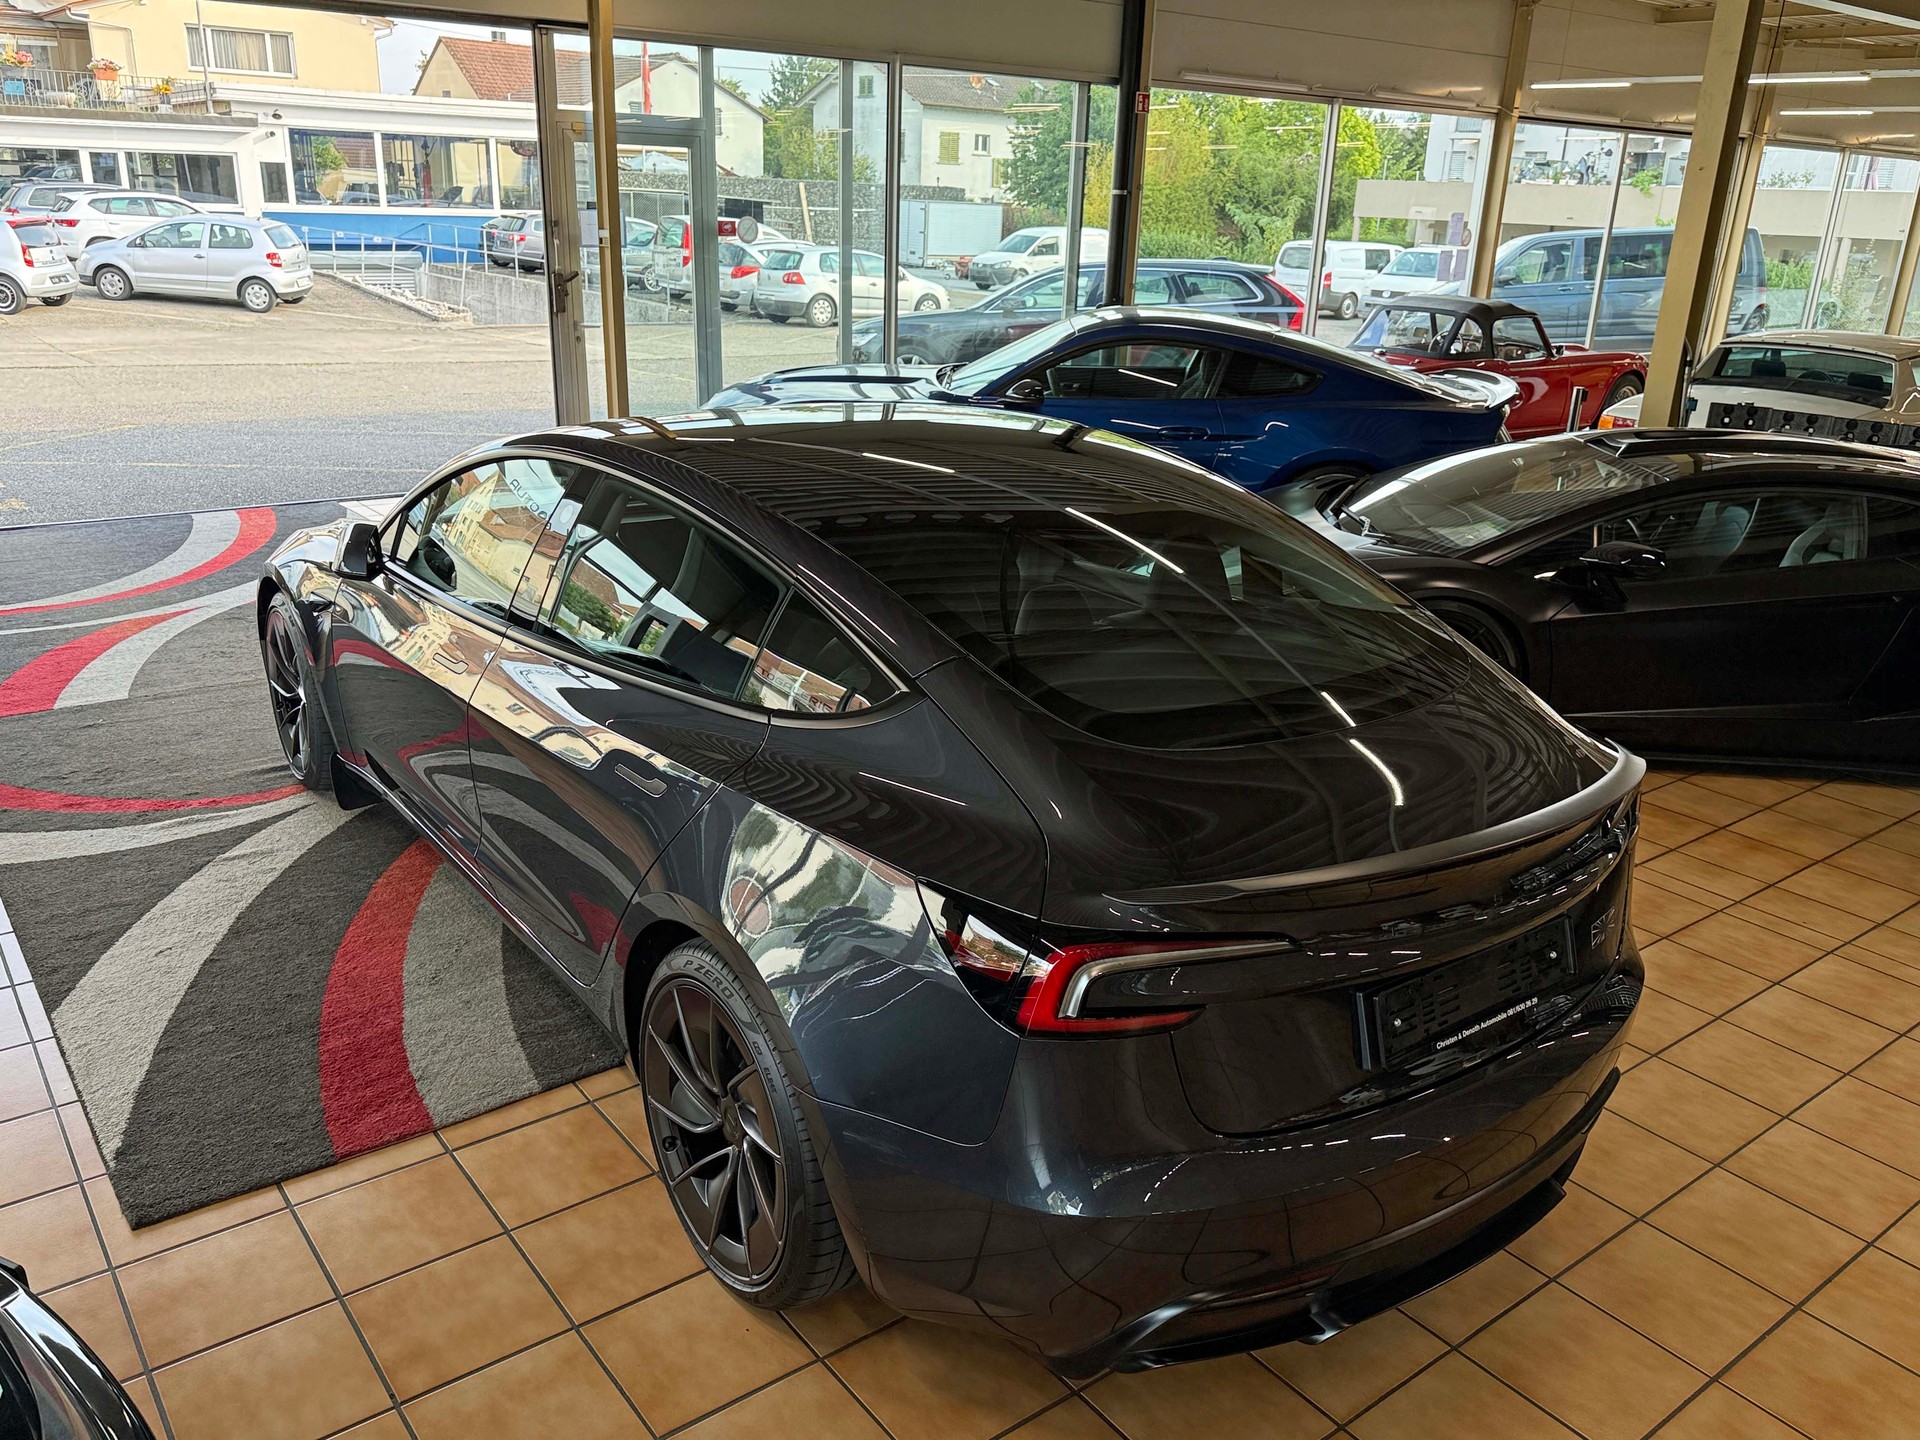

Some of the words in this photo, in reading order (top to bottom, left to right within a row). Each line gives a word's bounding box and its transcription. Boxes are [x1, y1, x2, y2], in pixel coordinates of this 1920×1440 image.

[683, 959, 694, 968] P
[693, 963, 735, 1000] ZERO
[1436, 1035, 1458, 1050] Christen
[1458, 1032, 1462, 1040] &
[1462, 1024, 1480, 1038] Denoth
[1480, 1012, 1507, 1030] Automobile
